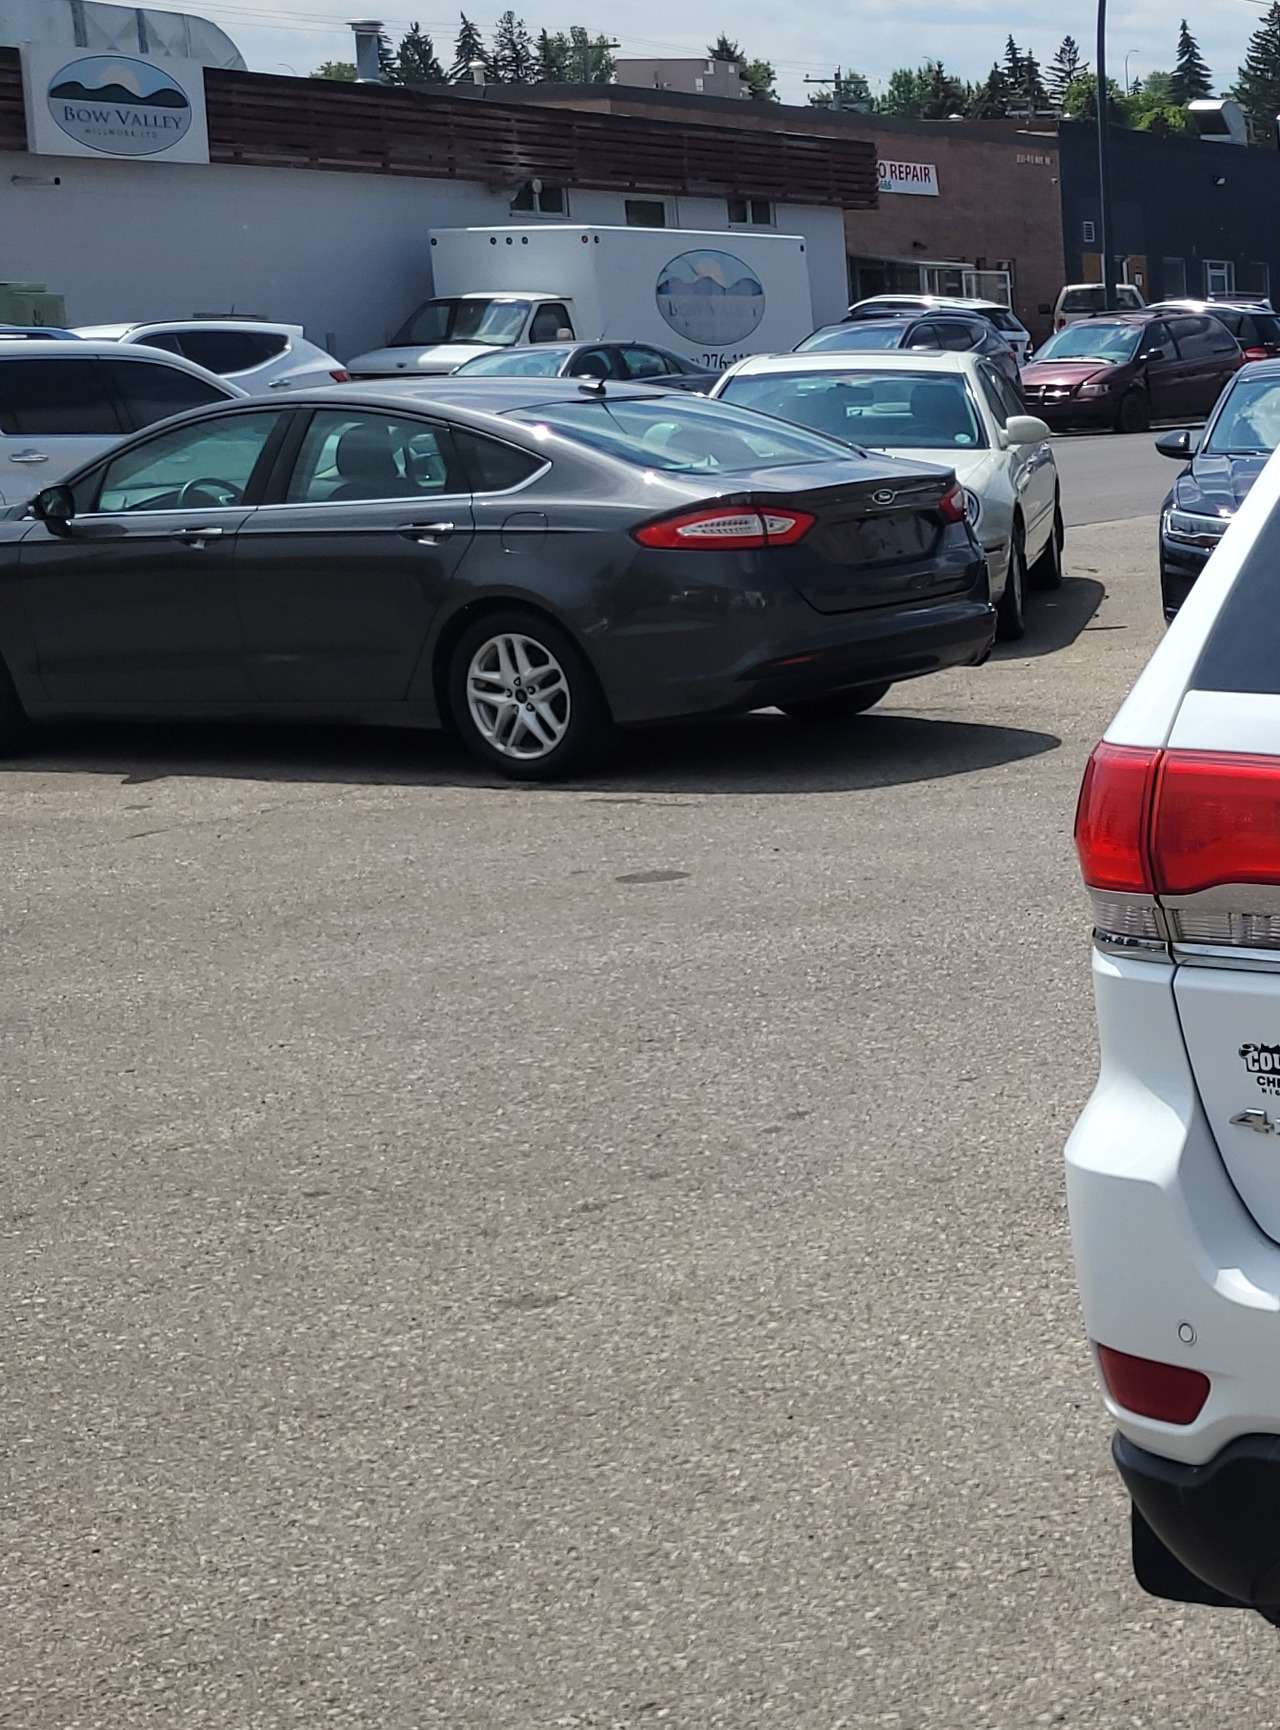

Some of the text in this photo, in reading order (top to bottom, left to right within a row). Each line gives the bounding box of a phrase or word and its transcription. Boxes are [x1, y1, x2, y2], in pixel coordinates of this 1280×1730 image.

[64, 105, 183, 129] BOW VALLEY
[889, 163, 931, 183] REPAIR
